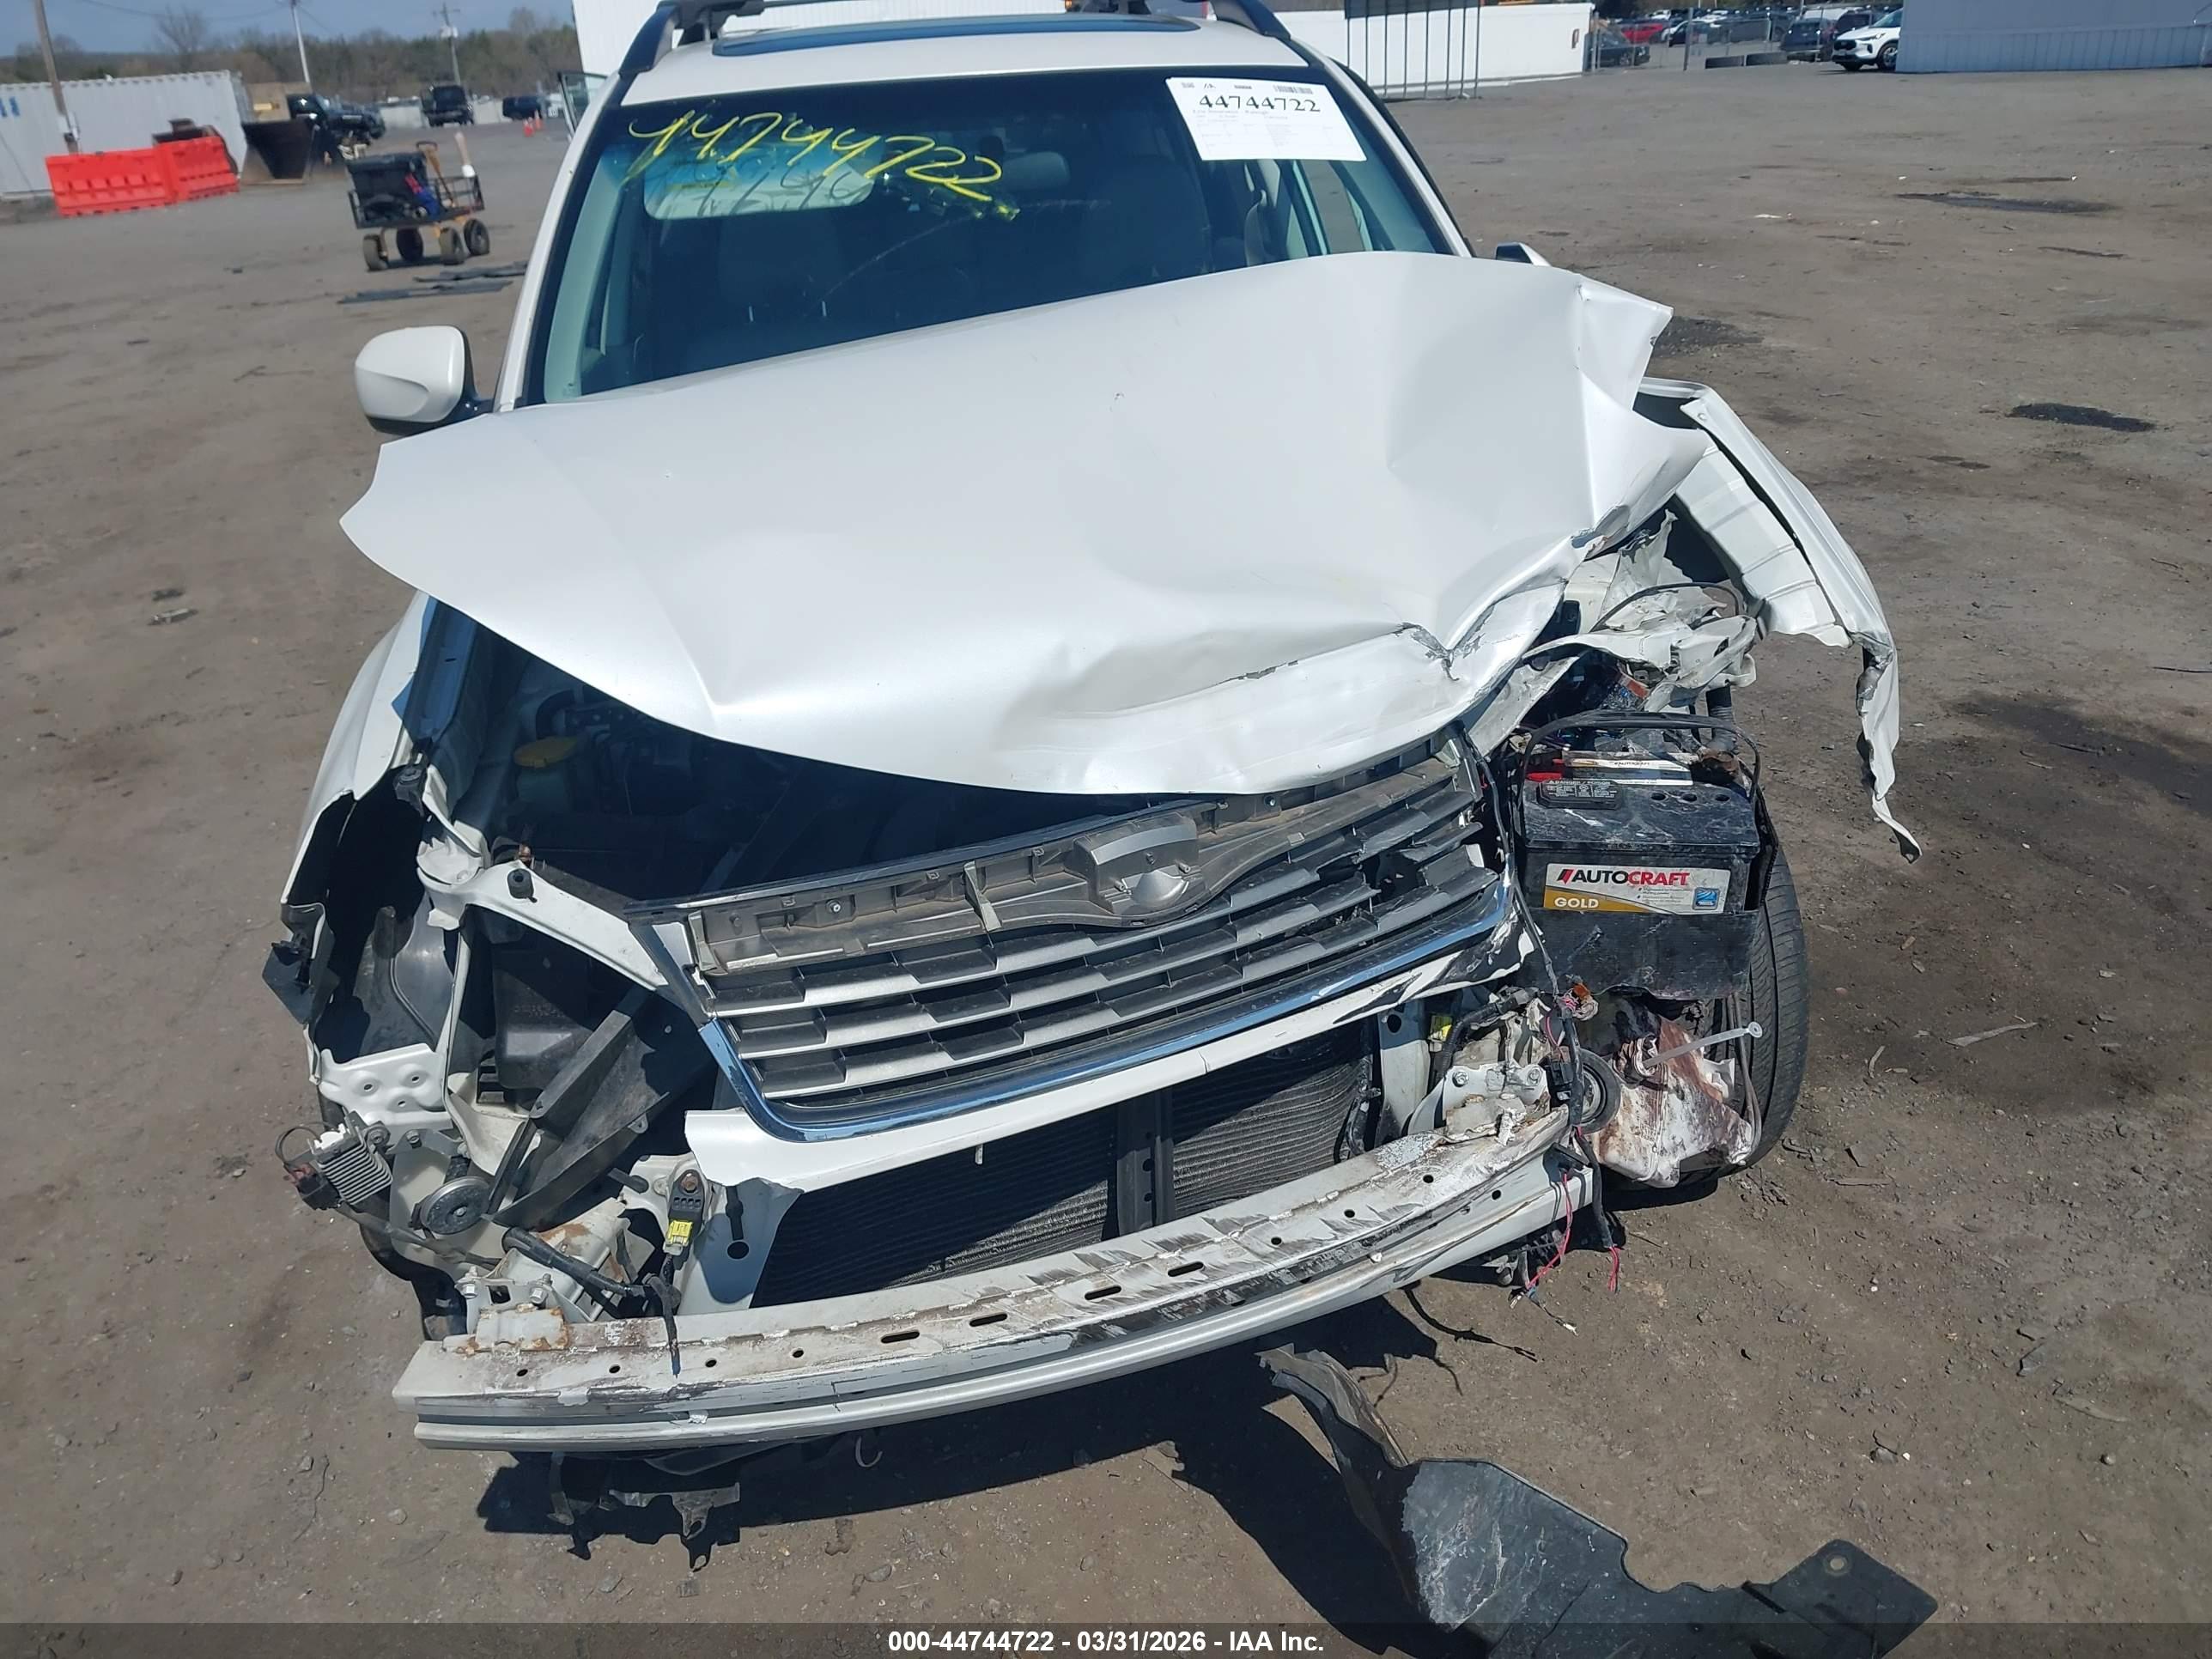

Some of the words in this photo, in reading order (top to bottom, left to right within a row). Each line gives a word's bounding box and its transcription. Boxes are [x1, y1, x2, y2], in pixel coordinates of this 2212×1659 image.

[1199, 94, 1322, 113] 44744722
[1571, 868, 1691, 886] AUTOCRAFT
[1553, 896, 1600, 908] GOLD
